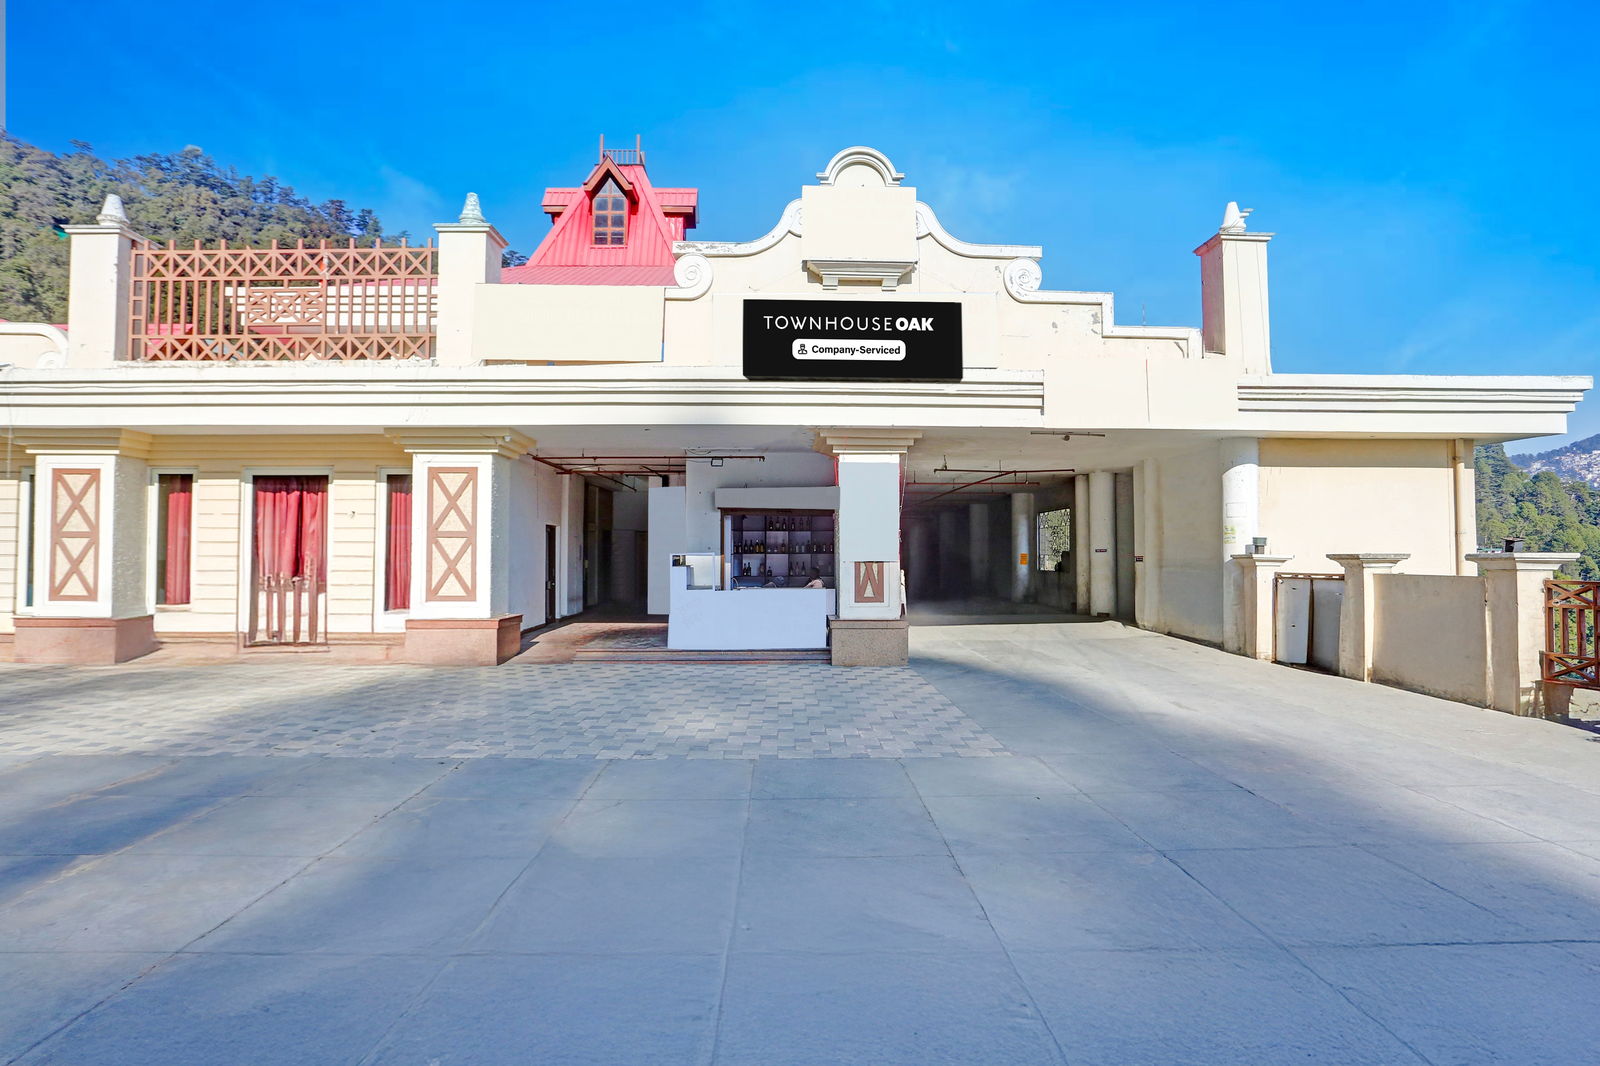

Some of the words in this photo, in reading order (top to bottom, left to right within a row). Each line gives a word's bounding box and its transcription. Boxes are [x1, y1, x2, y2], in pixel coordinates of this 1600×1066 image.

[763, 315, 893, 331] TOWNHOUSE
[895, 316, 934, 331] OAK
[811, 344, 901, 355] Company-Serviced
